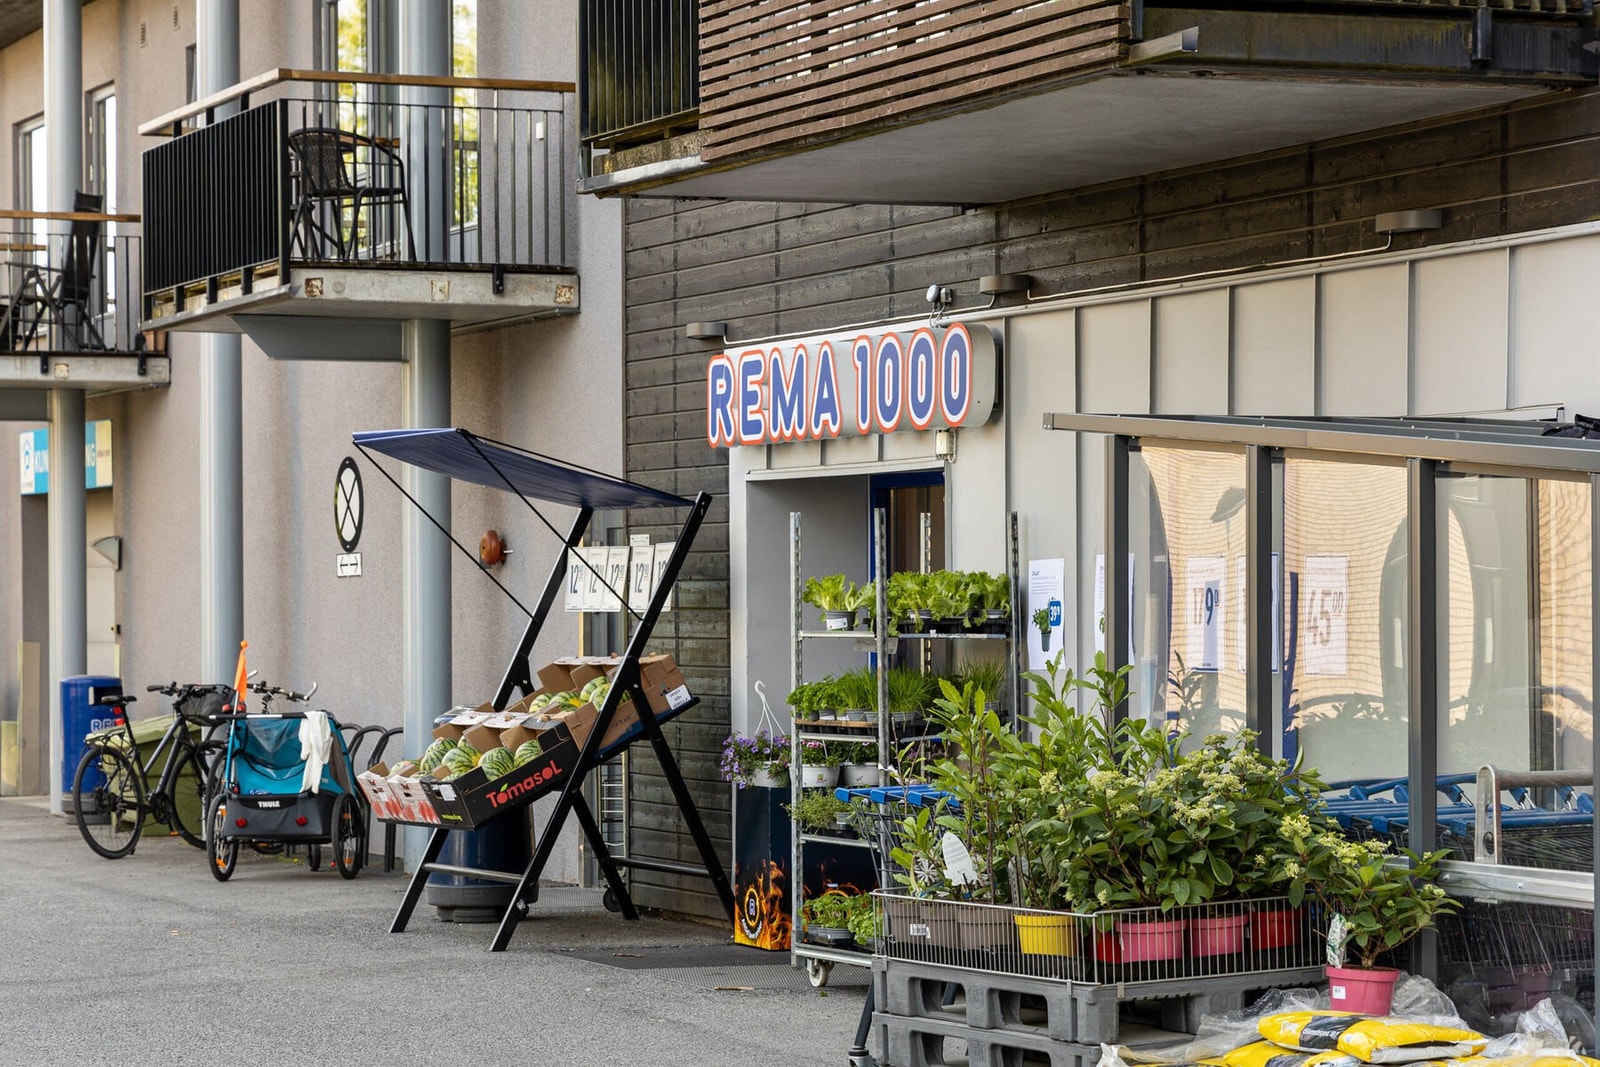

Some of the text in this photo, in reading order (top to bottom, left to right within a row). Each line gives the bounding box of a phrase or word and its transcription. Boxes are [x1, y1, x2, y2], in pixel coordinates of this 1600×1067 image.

[707, 322, 973, 448] REMA 1000
[570, 564, 580, 593] 12
[635, 563, 645, 593] 12
[1307, 589, 1331, 646] 45
